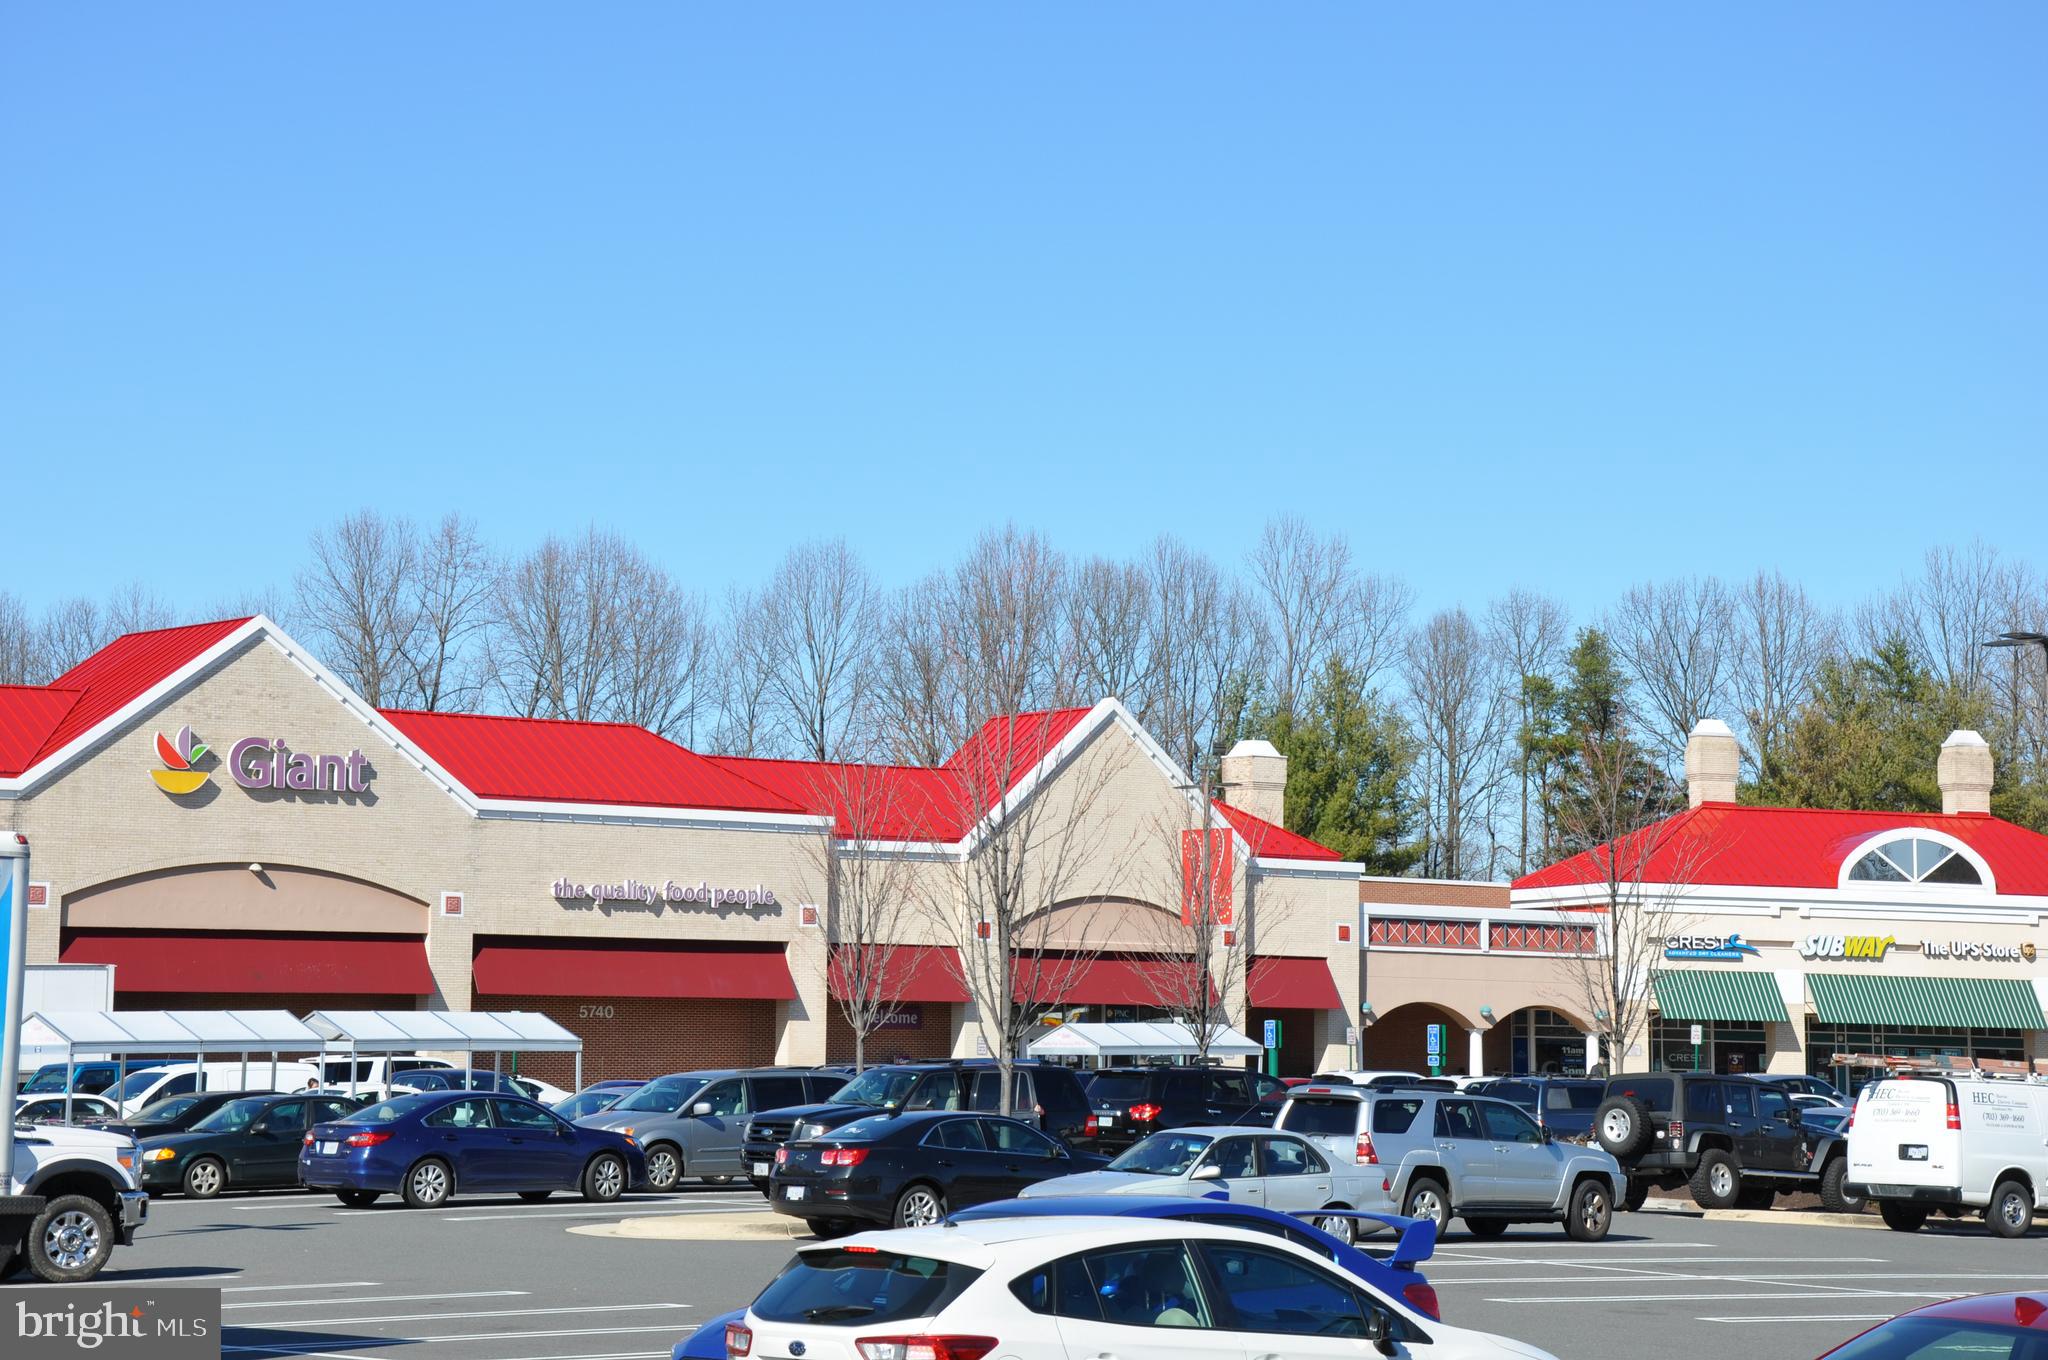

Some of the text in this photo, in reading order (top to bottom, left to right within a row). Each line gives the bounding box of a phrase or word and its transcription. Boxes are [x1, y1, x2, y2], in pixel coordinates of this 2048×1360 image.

[227, 737, 368, 792] Giant
[551, 878, 775, 909] the quality food people
[1665, 935, 1727, 950] CREST
[1803, 935, 1896, 958] SUBWAY
[1921, 940, 2020, 958] The UPS Store
[579, 1005, 614, 1019] 5740
[1114, 1009, 1130, 1018] PNC
[1561, 1046, 1584, 1054] 11am
[1972, 1092, 1995, 1104] HEC
